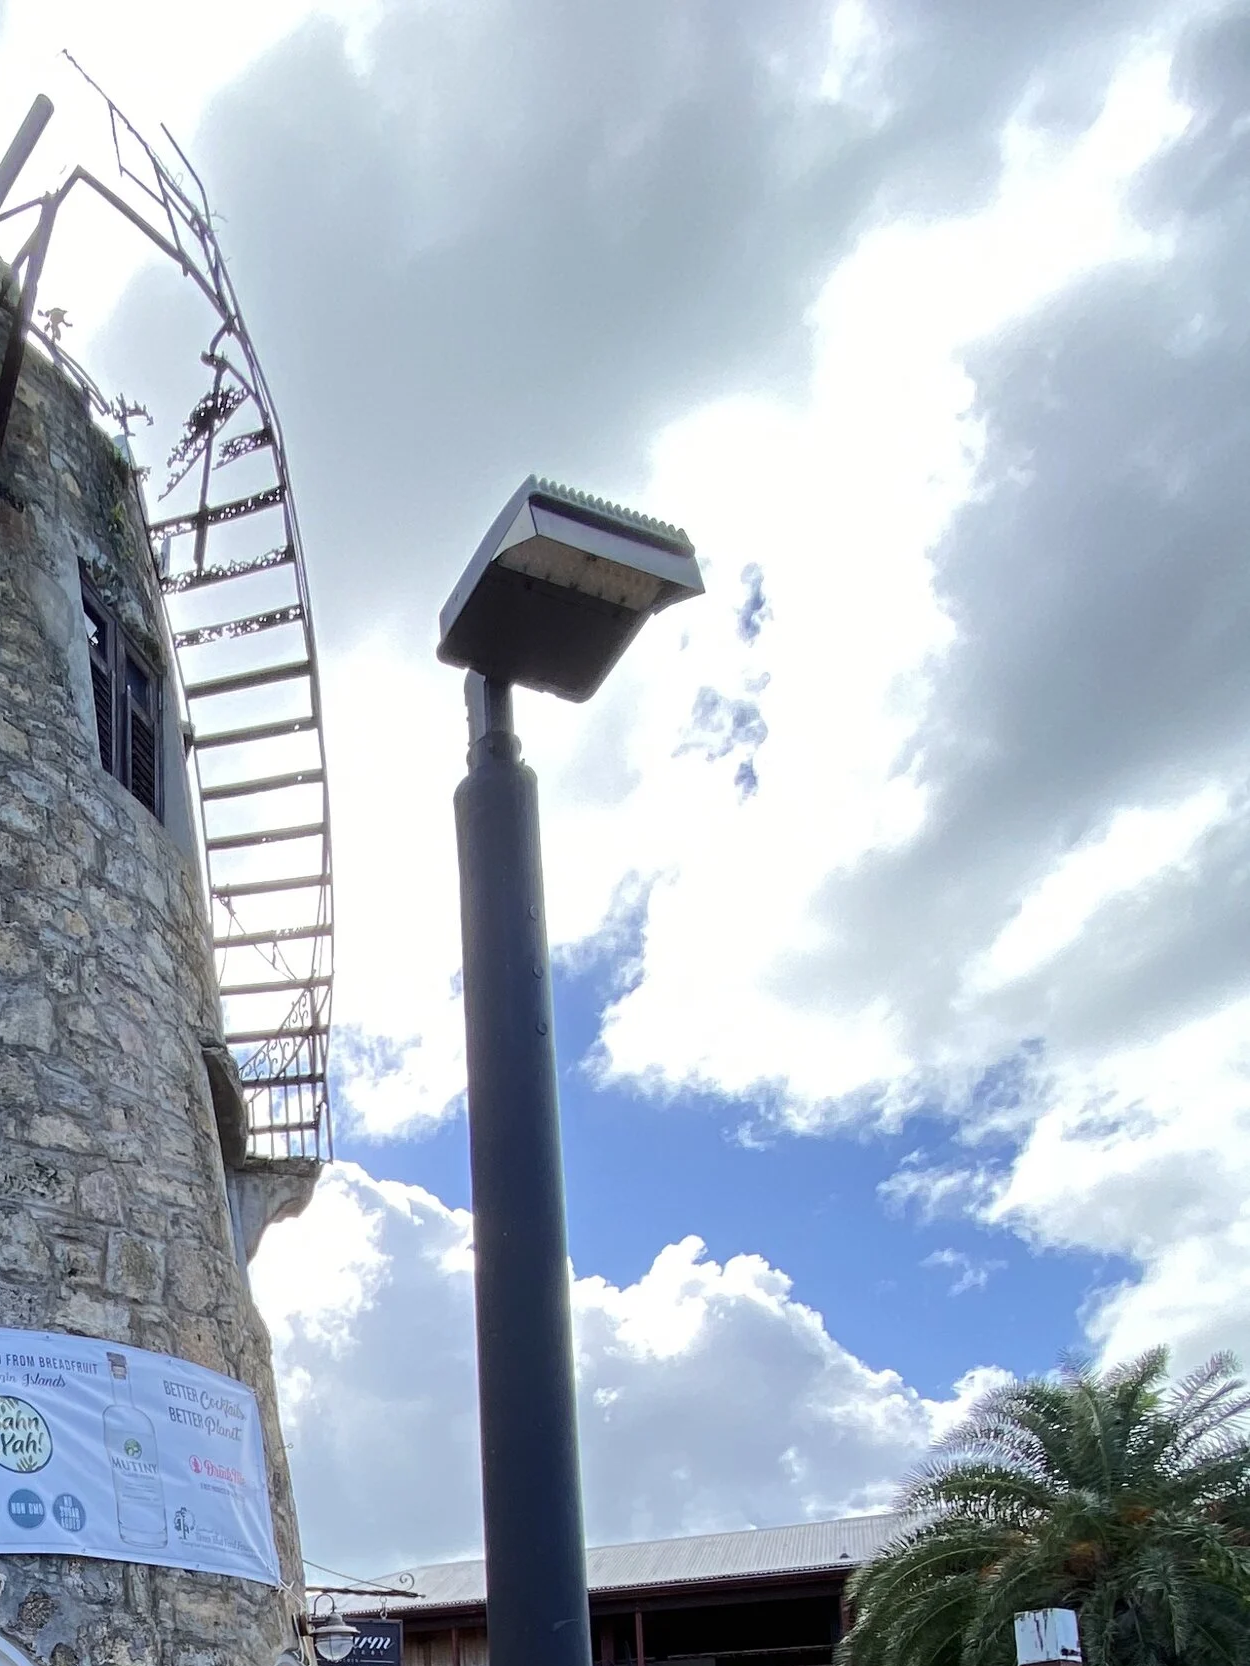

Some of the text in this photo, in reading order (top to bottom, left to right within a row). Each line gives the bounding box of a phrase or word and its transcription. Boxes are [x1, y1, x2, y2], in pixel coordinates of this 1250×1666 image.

[6, 1354, 35, 1368] FROM
[39, 1356, 98, 1375] BREADFRUIT
[21, 1373, 67, 1388] Islands
[163, 1380, 246, 1420] BETTER Cocktails
[168, 1406, 242, 1441] BETTER Planet
[0, 1432, 44, 1456] Yah!
[111, 1456, 158, 1474] MUTINY
[11, 1502, 44, 1515] NON GMO
